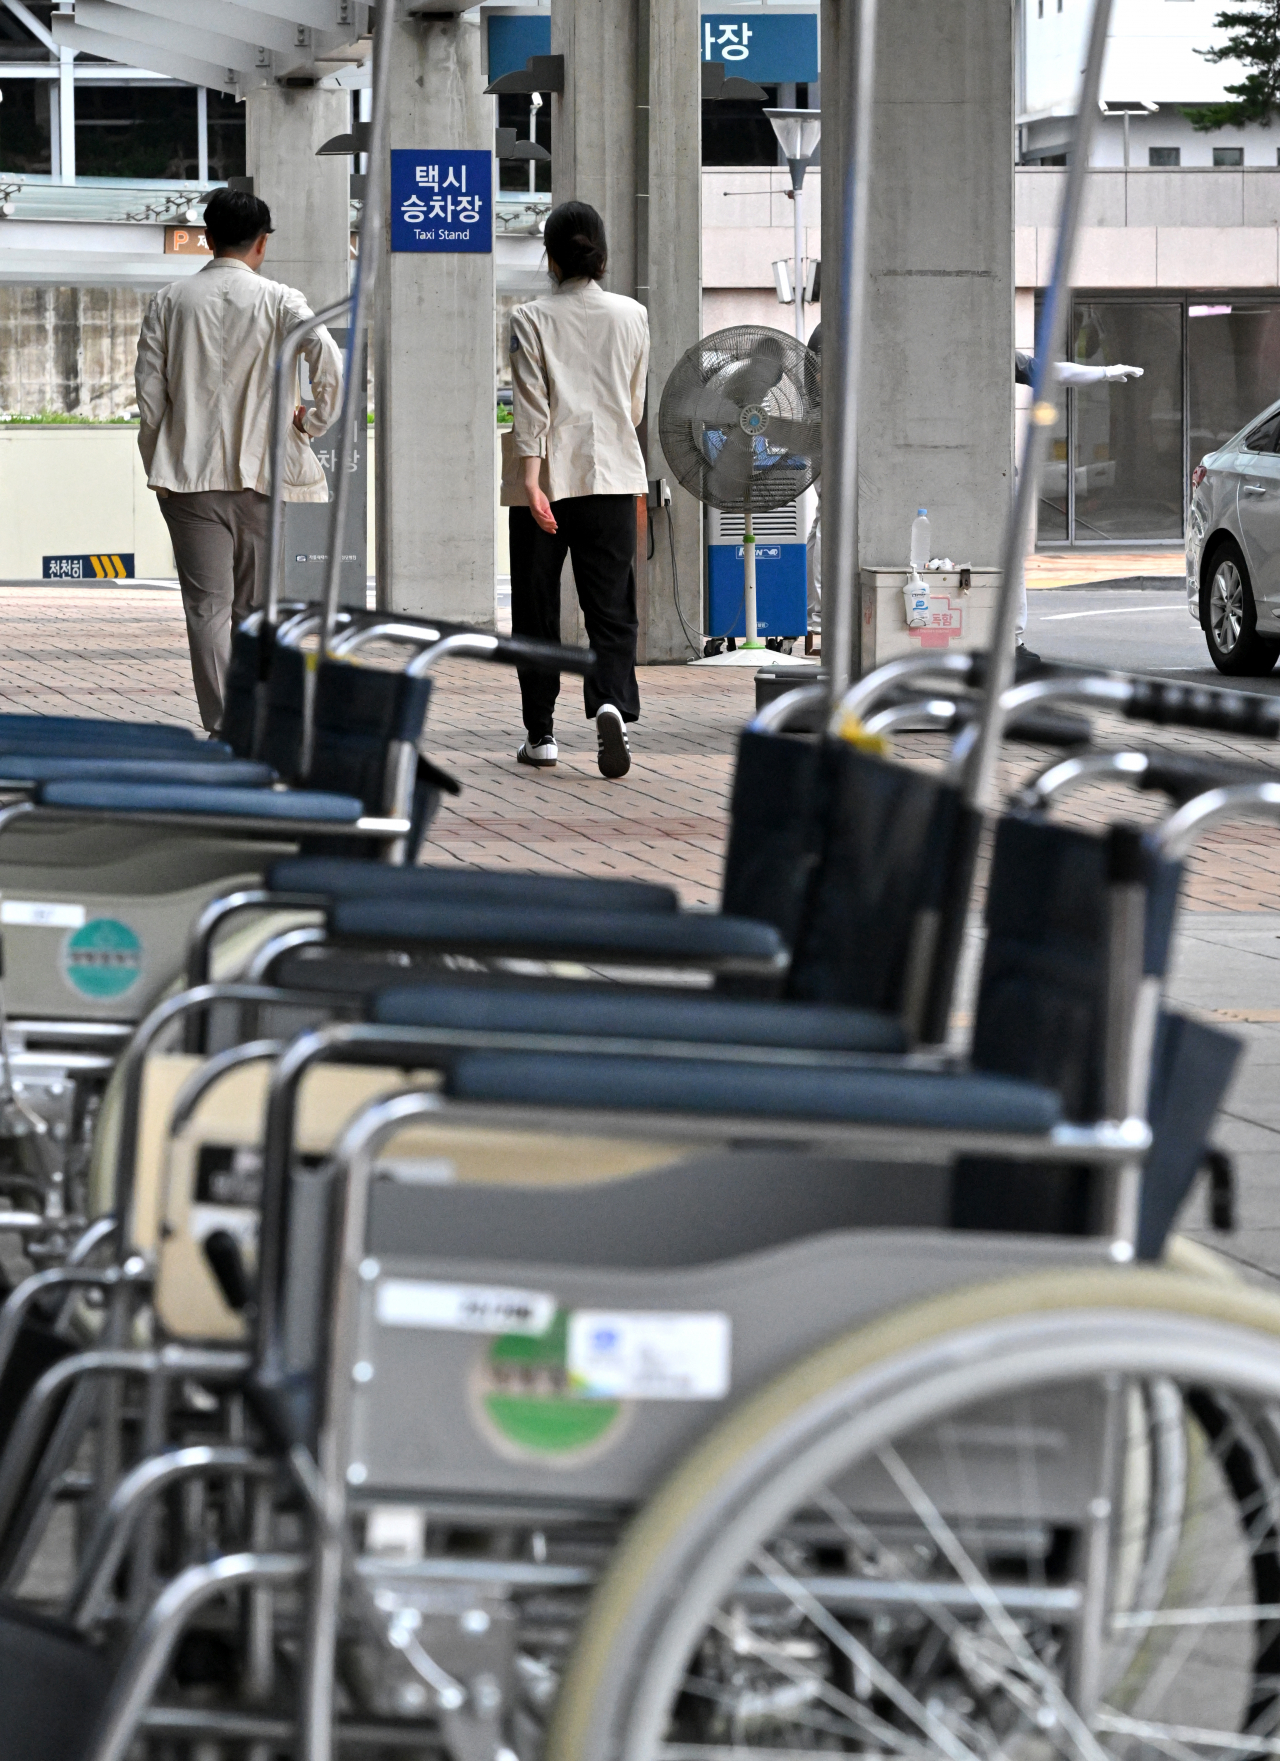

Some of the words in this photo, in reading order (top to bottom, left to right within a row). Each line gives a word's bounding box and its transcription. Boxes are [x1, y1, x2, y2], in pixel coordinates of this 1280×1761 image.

[415, 164, 467, 193] 택시
[400, 194, 483, 223] 승차장
[173, 230, 189, 251] P
[413, 228, 435, 240] Taxi
[438, 228, 470, 240] Stand
[49, 559, 83, 579] 천천히
